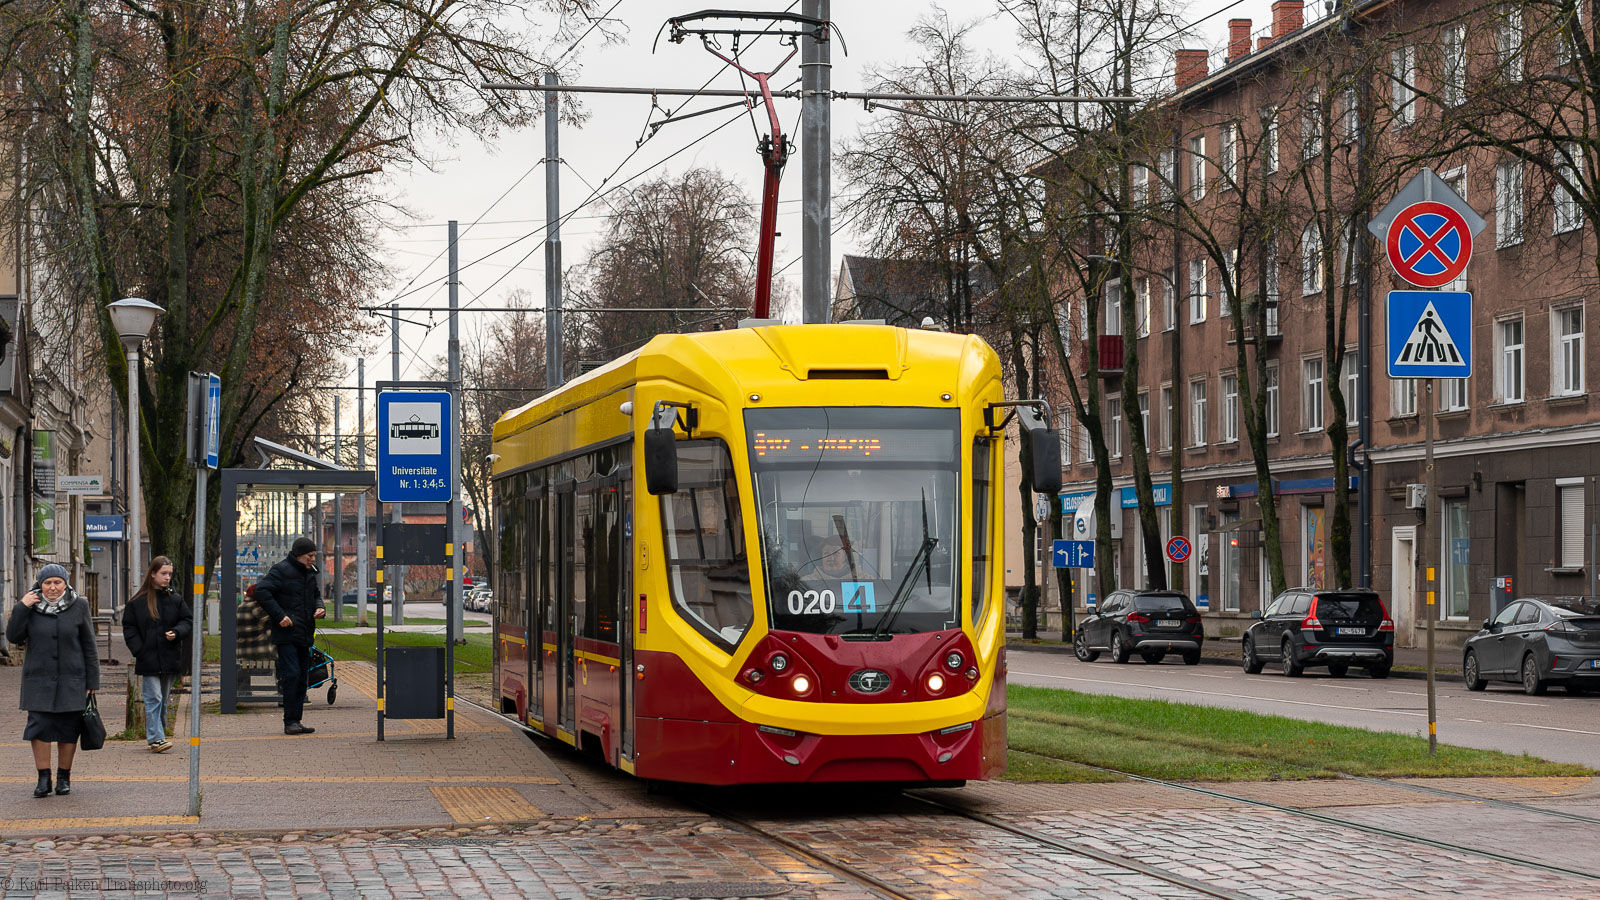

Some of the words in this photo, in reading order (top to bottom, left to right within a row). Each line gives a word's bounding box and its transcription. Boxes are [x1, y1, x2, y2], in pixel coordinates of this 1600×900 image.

[392, 466, 437, 475] Universitāte
[400, 479, 411, 488] Nr.
[788, 590, 835, 615] 020
[848, 586, 871, 613] 4
